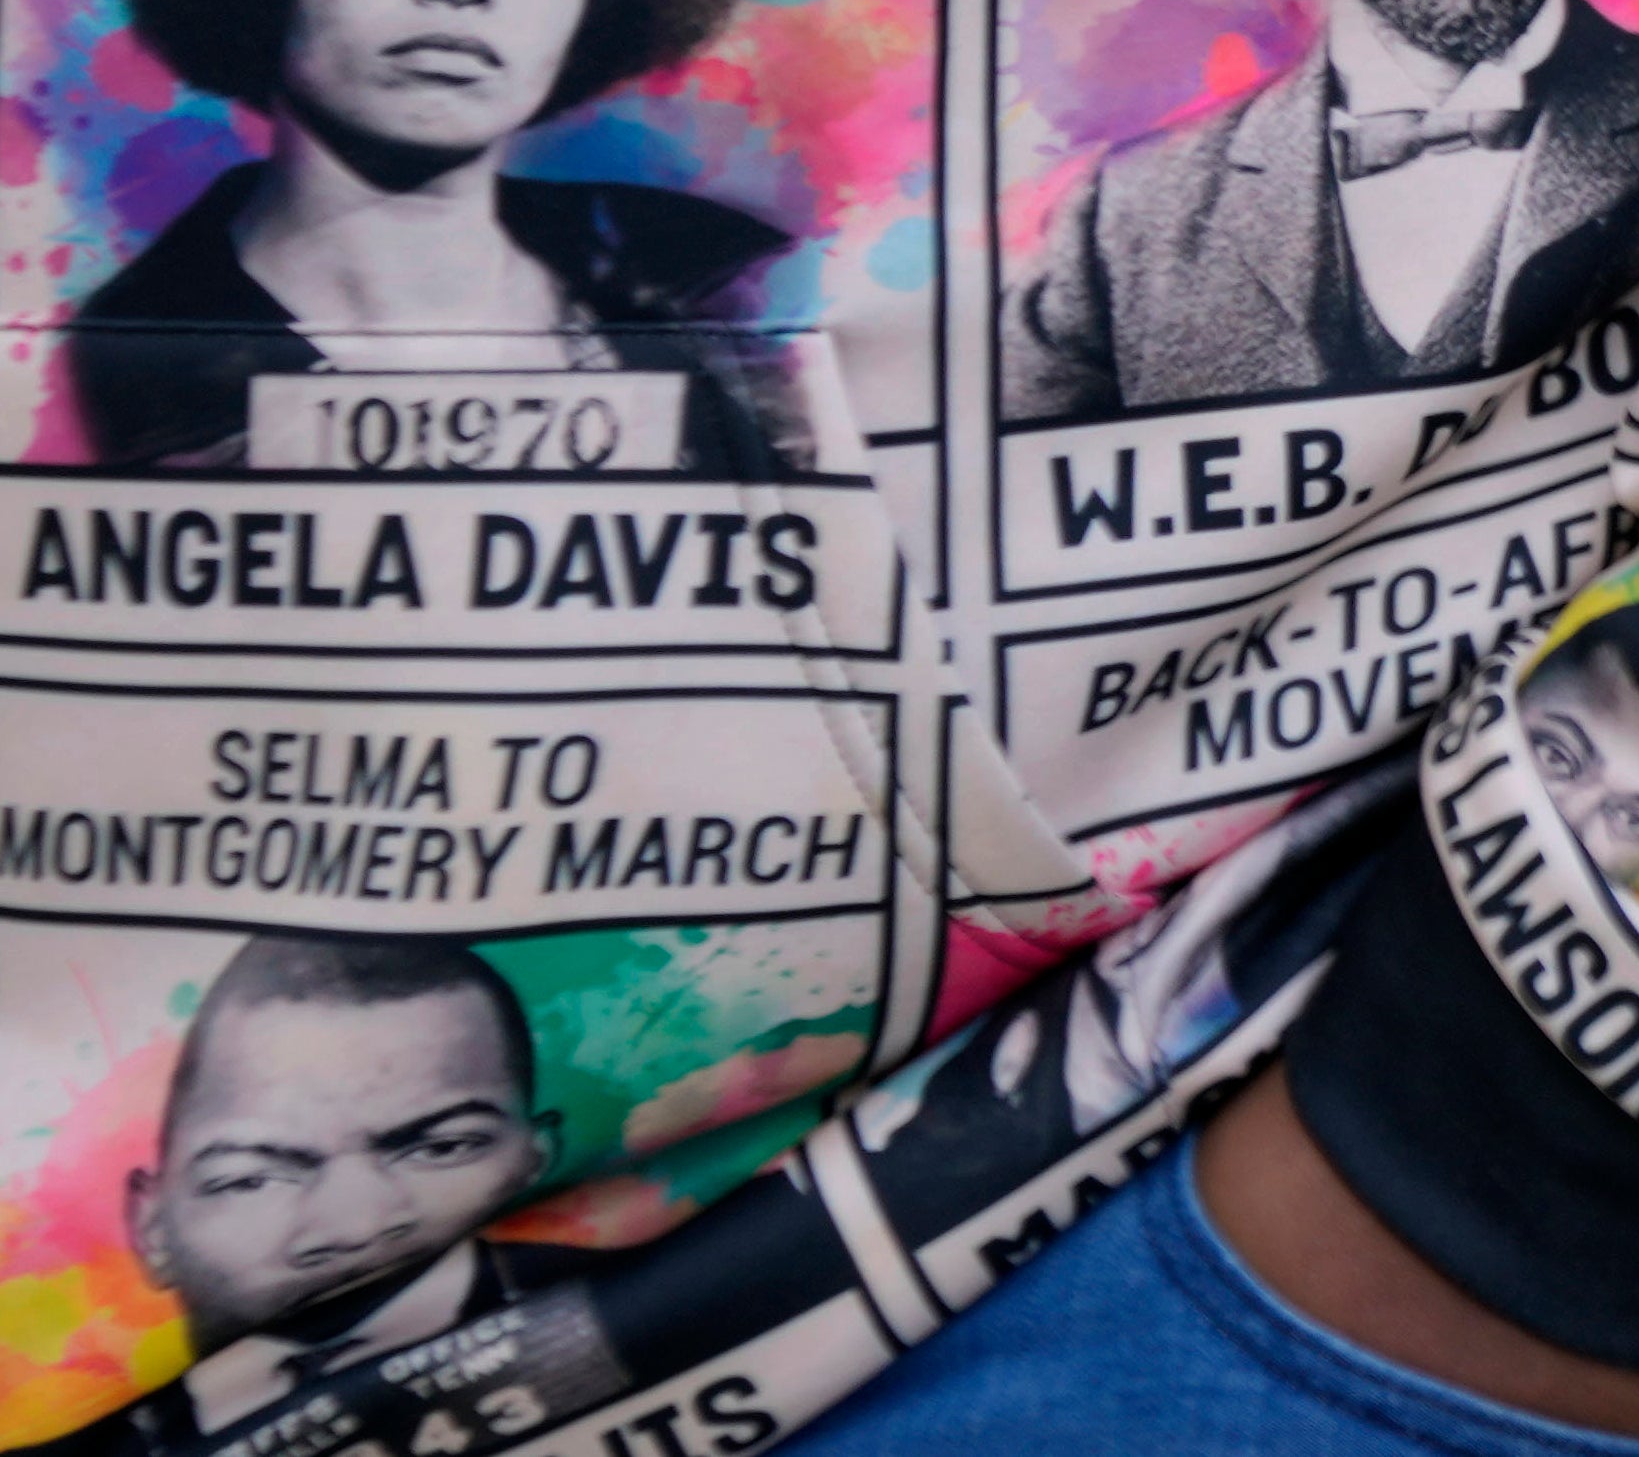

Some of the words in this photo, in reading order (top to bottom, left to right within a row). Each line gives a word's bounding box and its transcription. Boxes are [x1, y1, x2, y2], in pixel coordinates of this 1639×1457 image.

[1049, 427, 1374, 550] W.E.B.
[22, 507, 426, 609] ANGELA
[469, 510, 820, 611] DAVIS
[209, 728, 454, 813] SELMA
[493, 732, 602, 806] TO
[0, 806, 521, 904] MONTGOMERY
[539, 811, 866, 894] MARCH
